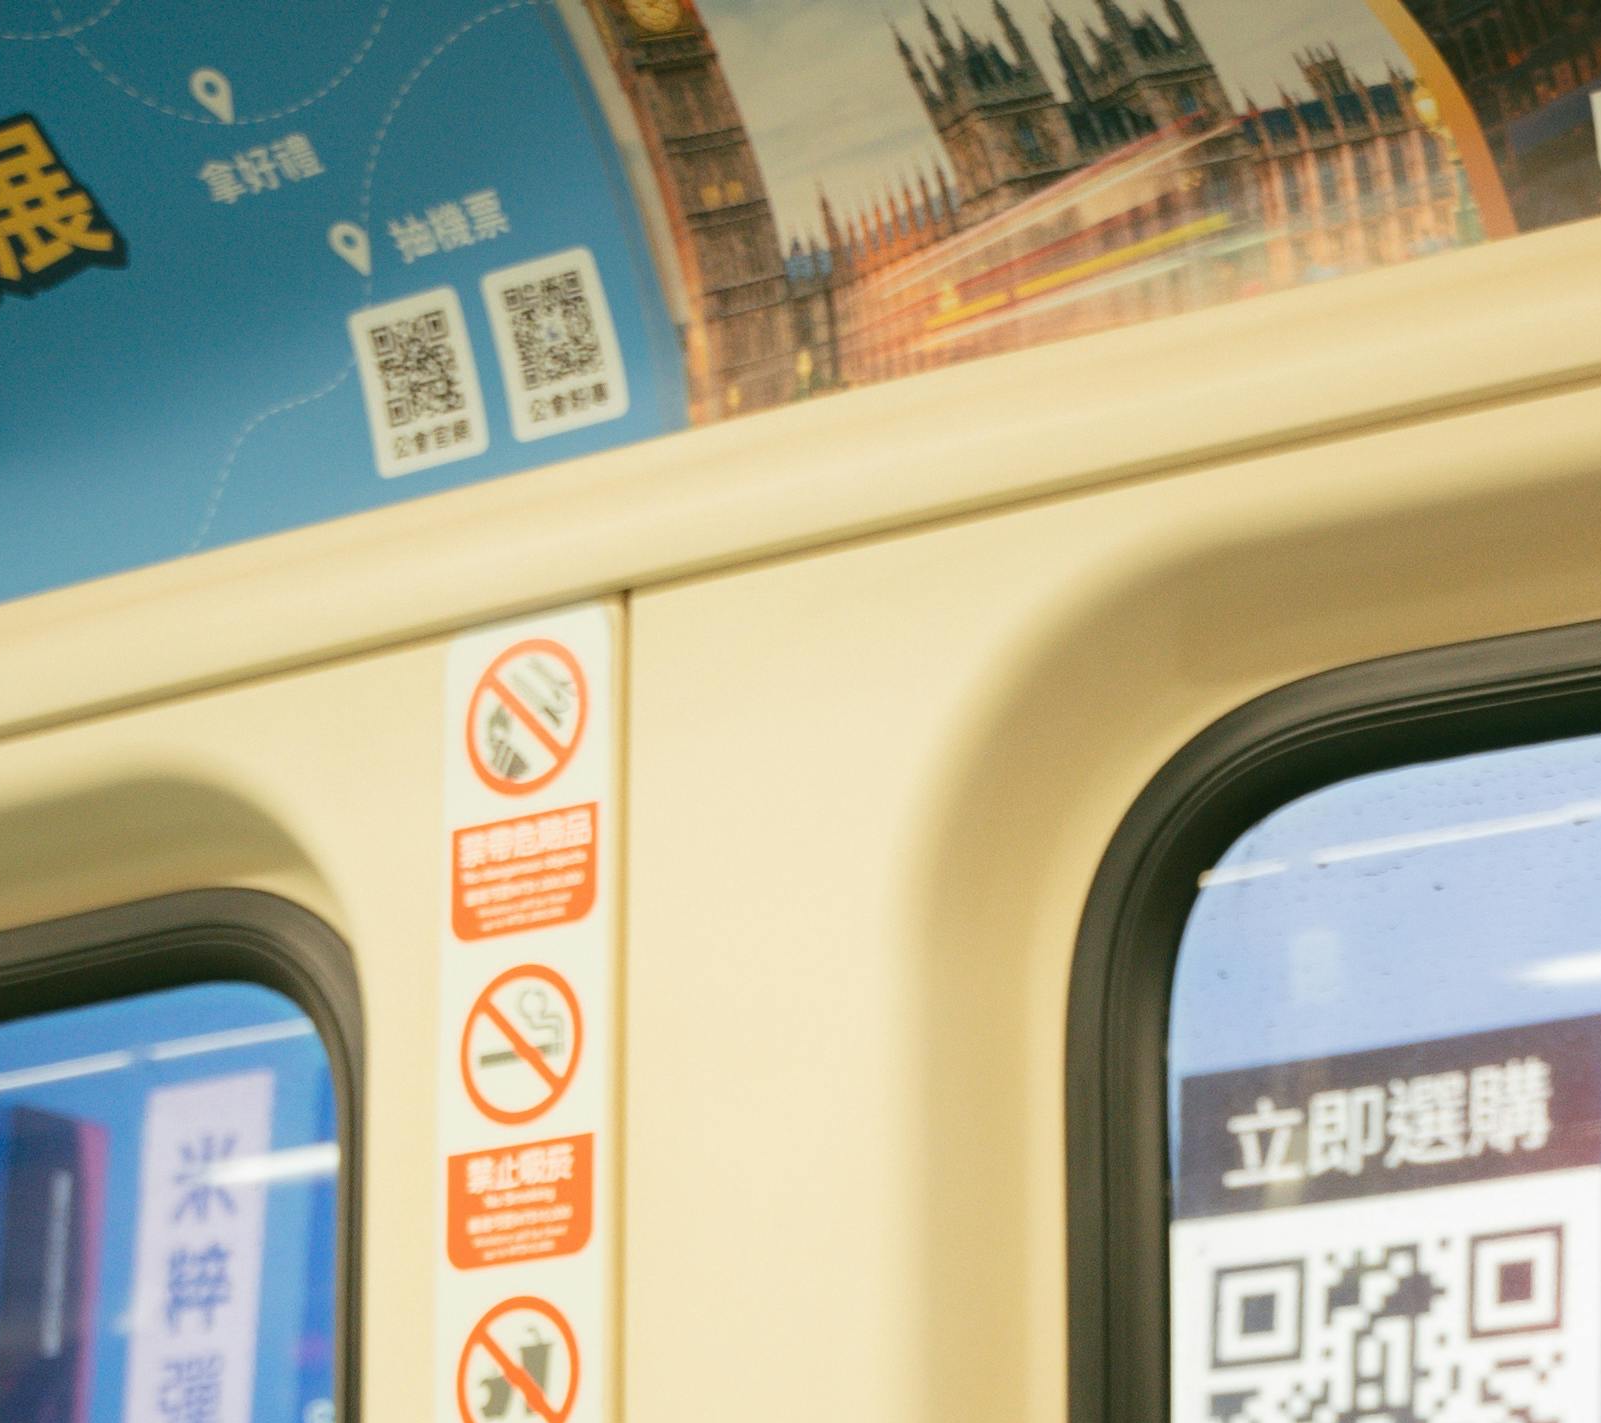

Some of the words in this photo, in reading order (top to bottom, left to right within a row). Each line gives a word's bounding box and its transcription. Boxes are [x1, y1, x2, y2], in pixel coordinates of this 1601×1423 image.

[198, 132, 325, 204] 拿好禮
[388, 188, 511, 263] 抽機票
[1223, 1059, 1553, 1188] 立即選購
